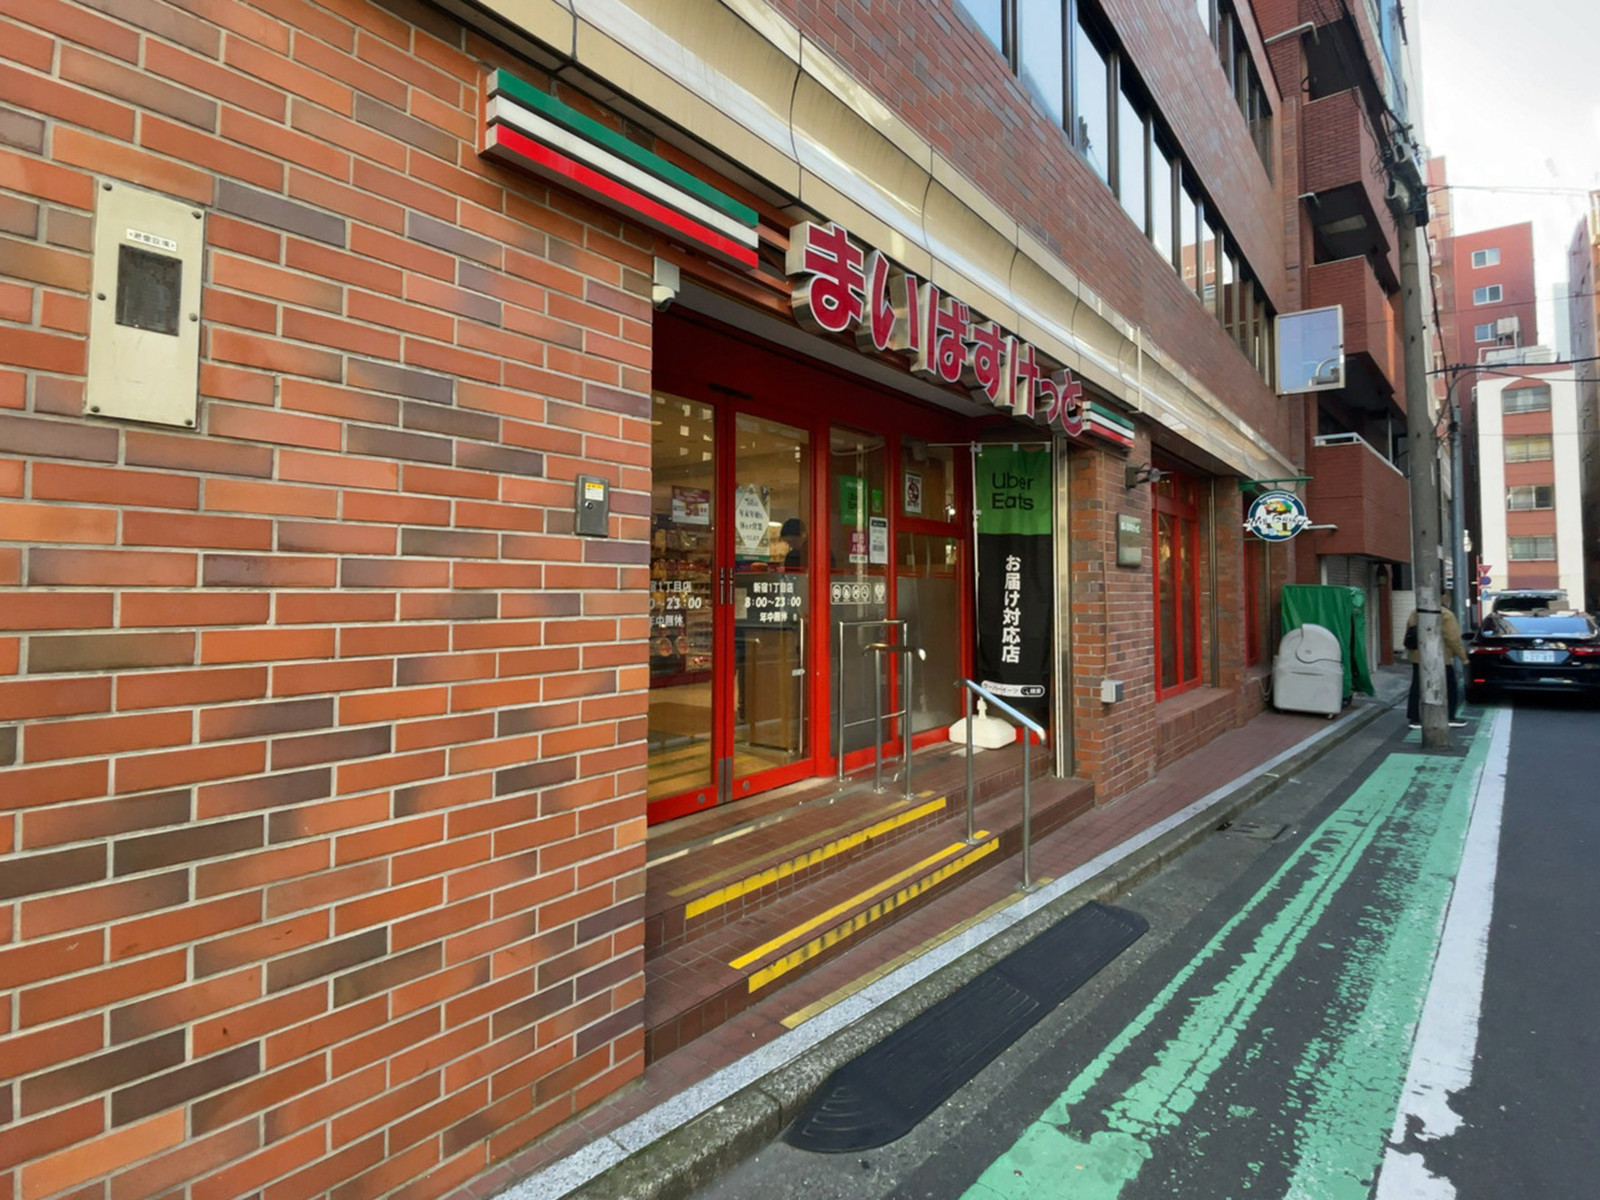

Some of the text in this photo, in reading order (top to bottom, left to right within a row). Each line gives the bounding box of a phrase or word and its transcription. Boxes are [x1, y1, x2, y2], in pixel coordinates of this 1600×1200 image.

[803, 220, 1084, 437] まいばすけっと
[992, 472, 1034, 491] Uber
[991, 492, 1034, 511] Eats
[753, 582, 794, 594] 新宿1丁目店
[1001, 554, 1021, 663] お届け対応店
